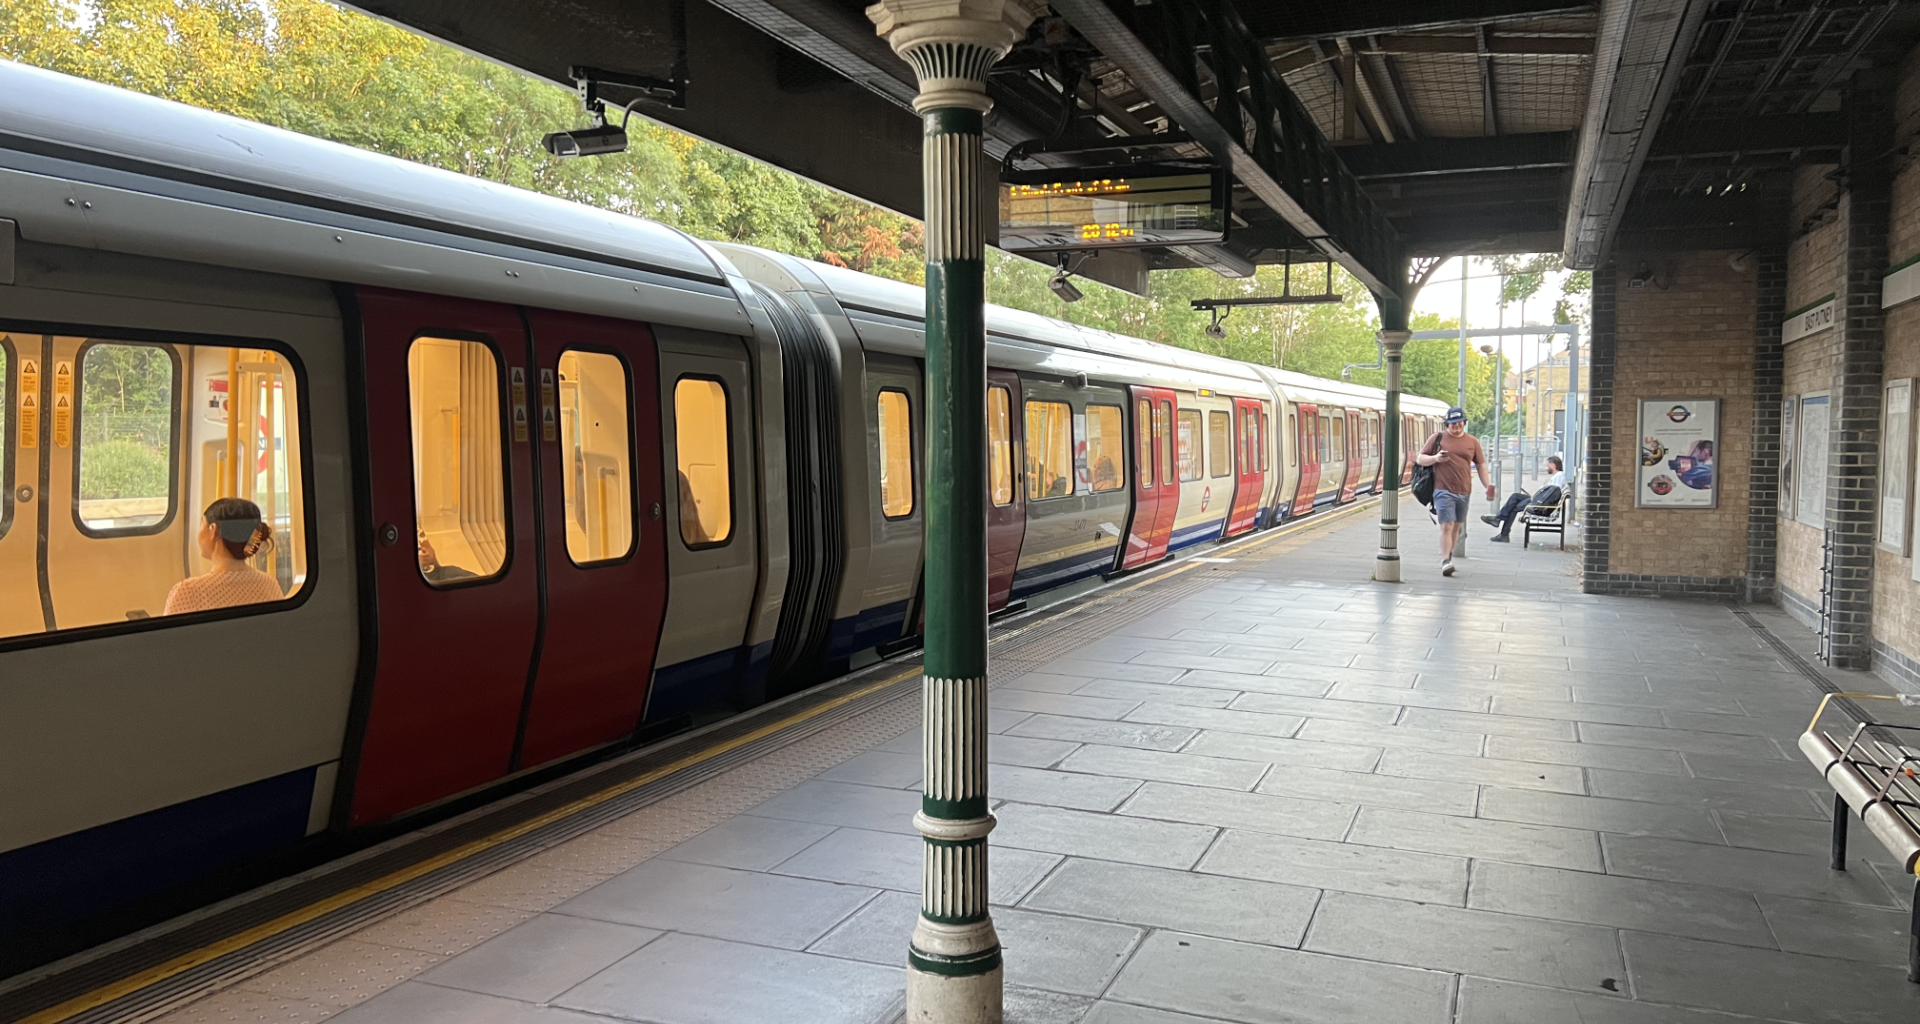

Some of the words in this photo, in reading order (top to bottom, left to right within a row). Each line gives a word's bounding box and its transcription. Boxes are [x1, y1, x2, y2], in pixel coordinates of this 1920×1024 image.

[1053, 181, 1084, 194] Front
[1087, 179, 1099, 192] of
[1102, 178, 1130, 191] Train
[1805, 313, 1815, 331] EAST
[1815, 306, 1832, 326] PUTNEY
